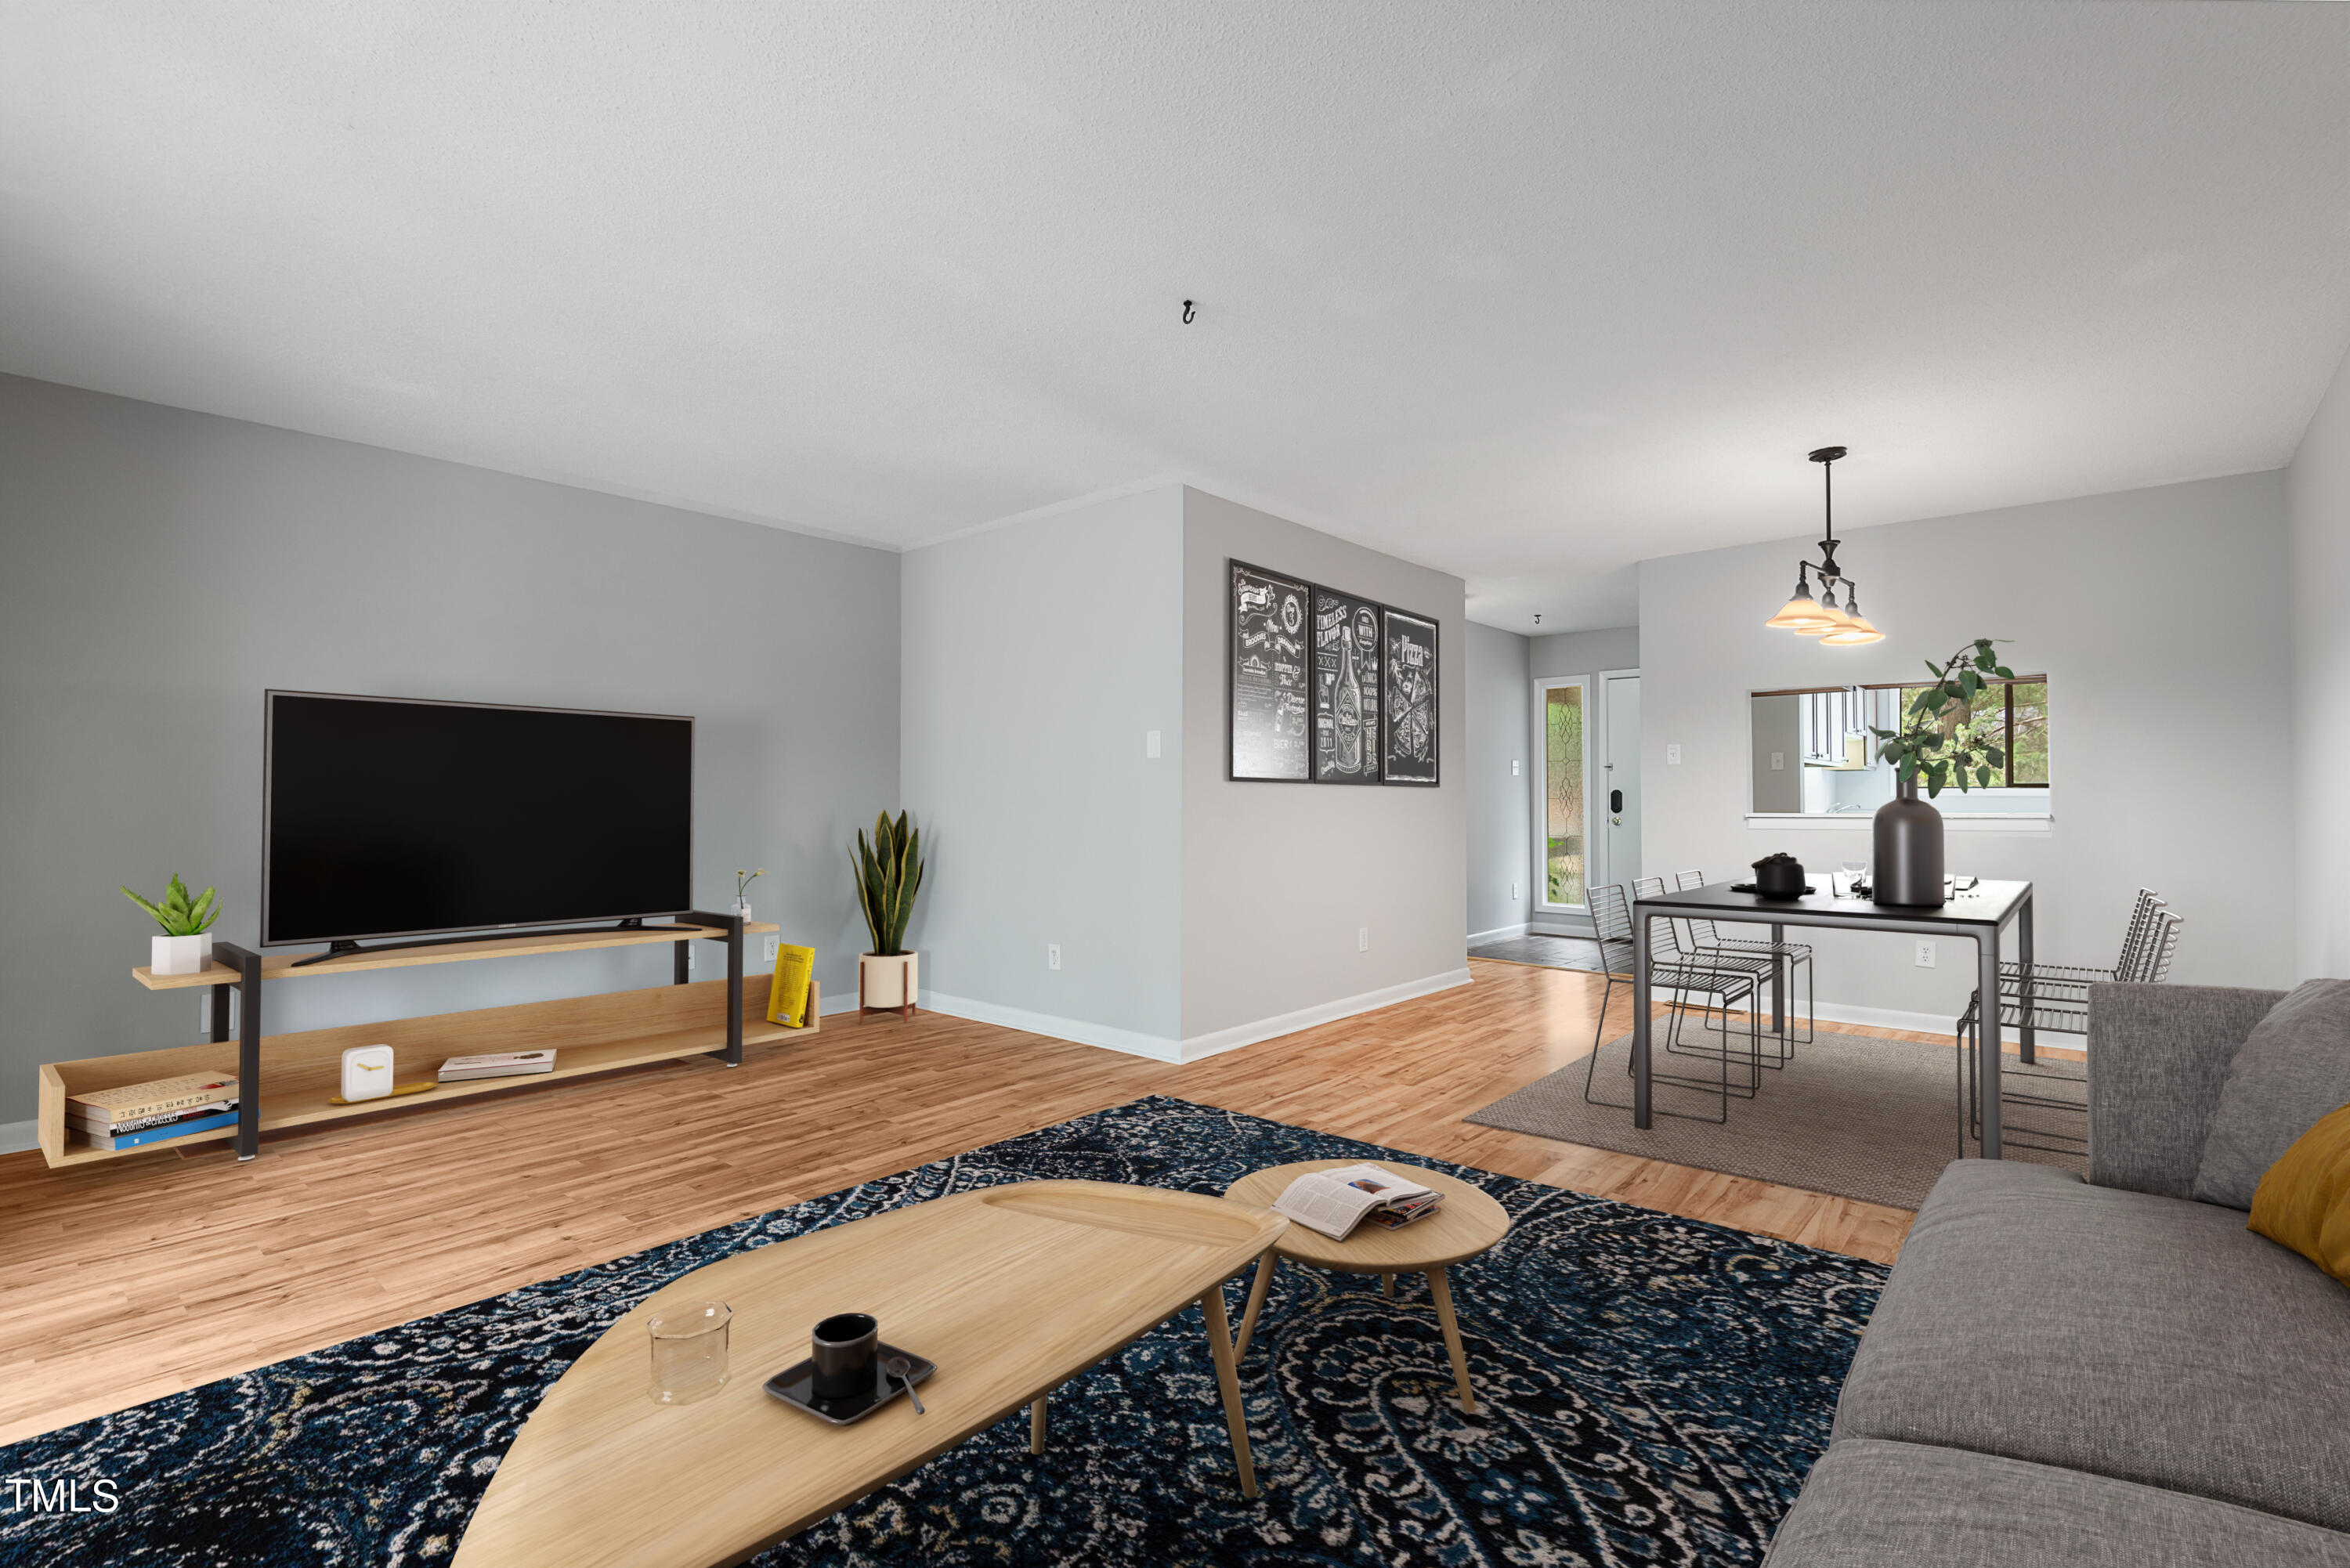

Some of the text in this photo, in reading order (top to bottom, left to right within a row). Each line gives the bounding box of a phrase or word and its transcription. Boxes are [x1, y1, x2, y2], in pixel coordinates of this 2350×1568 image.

[1317, 605, 1347, 630] TIMELESS
[1317, 623, 1341, 648] FLAVOR
[1358, 624, 1373, 638] WITH
[1401, 634, 1423, 667] Pizza
[1363, 686, 1378, 697] 100%
[1274, 739, 1289, 750] BIER
[1320, 737, 1332, 748] 2011
